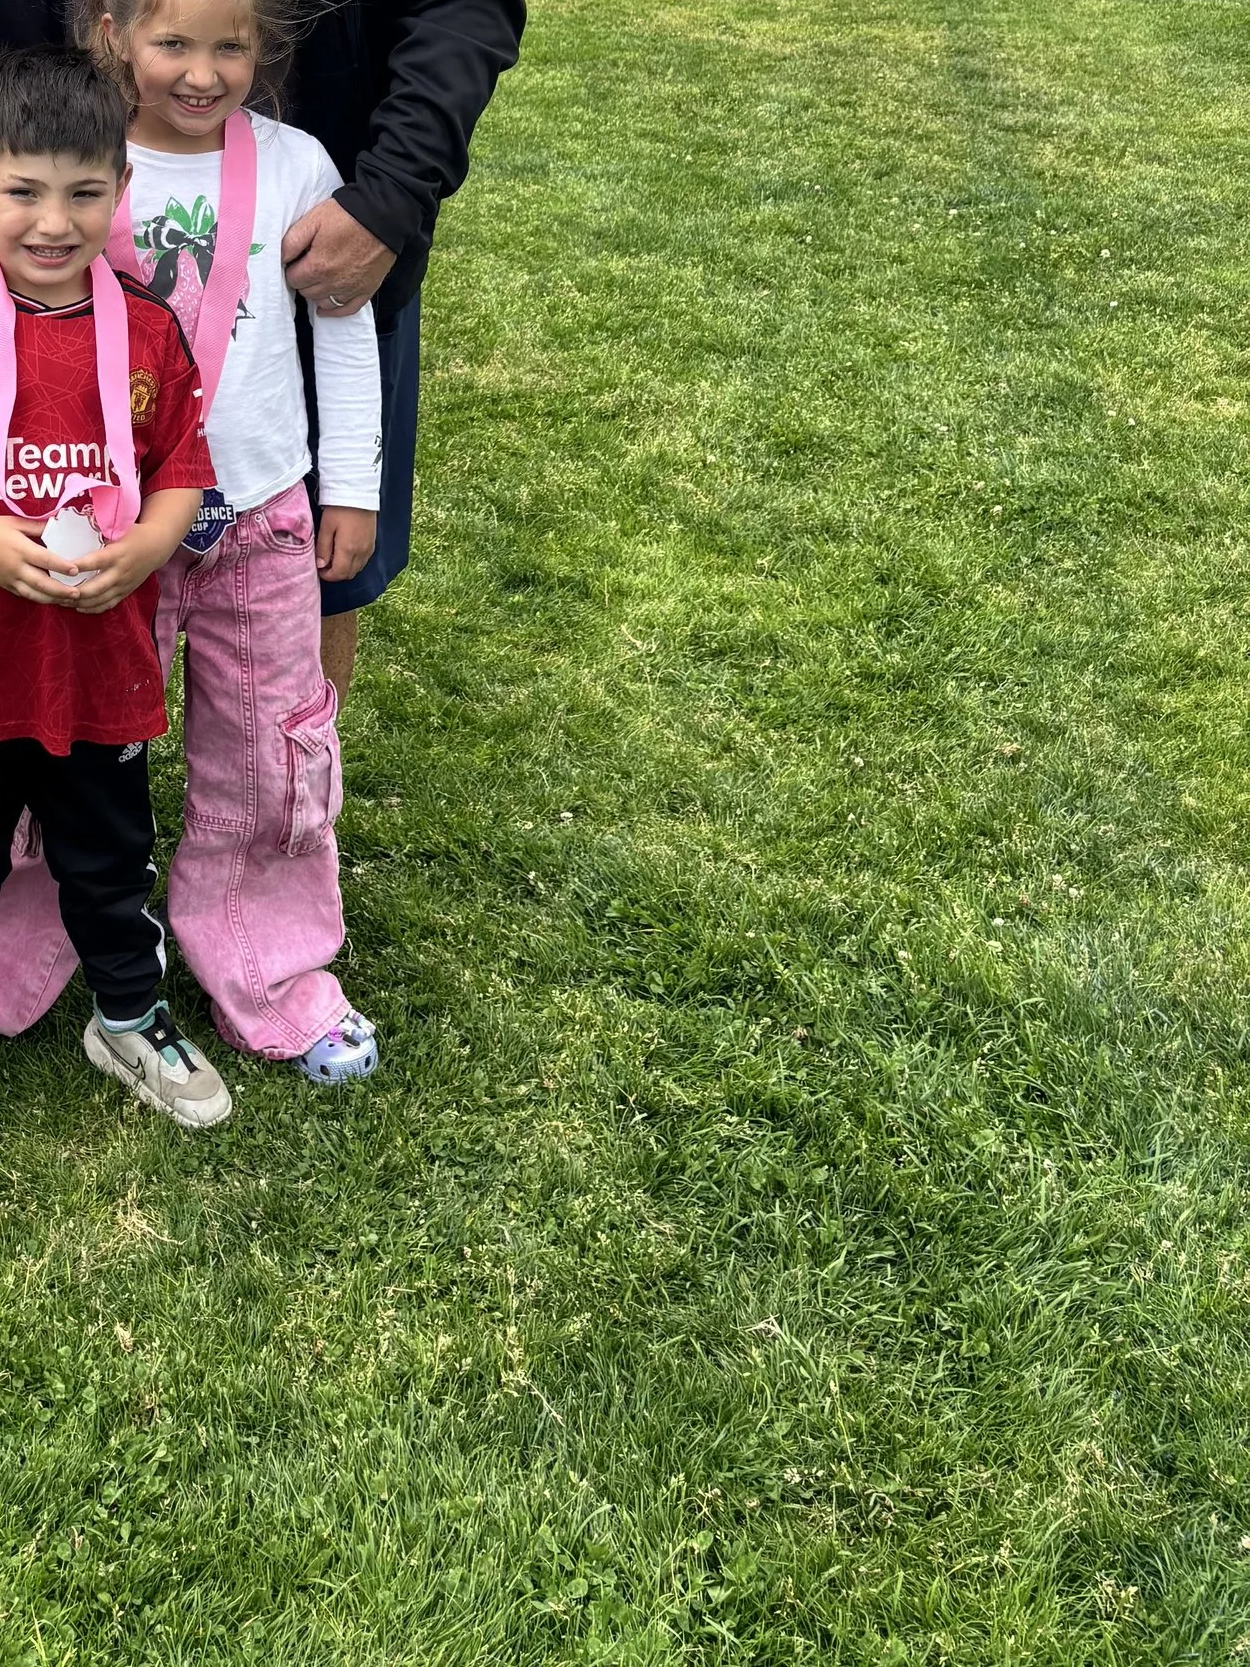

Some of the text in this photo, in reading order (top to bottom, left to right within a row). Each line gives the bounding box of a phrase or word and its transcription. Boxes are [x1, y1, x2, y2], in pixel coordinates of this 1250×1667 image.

[6, 436, 101, 470] Team
[195, 506, 233, 522] DENCE
[191, 521, 209, 532] CUP
